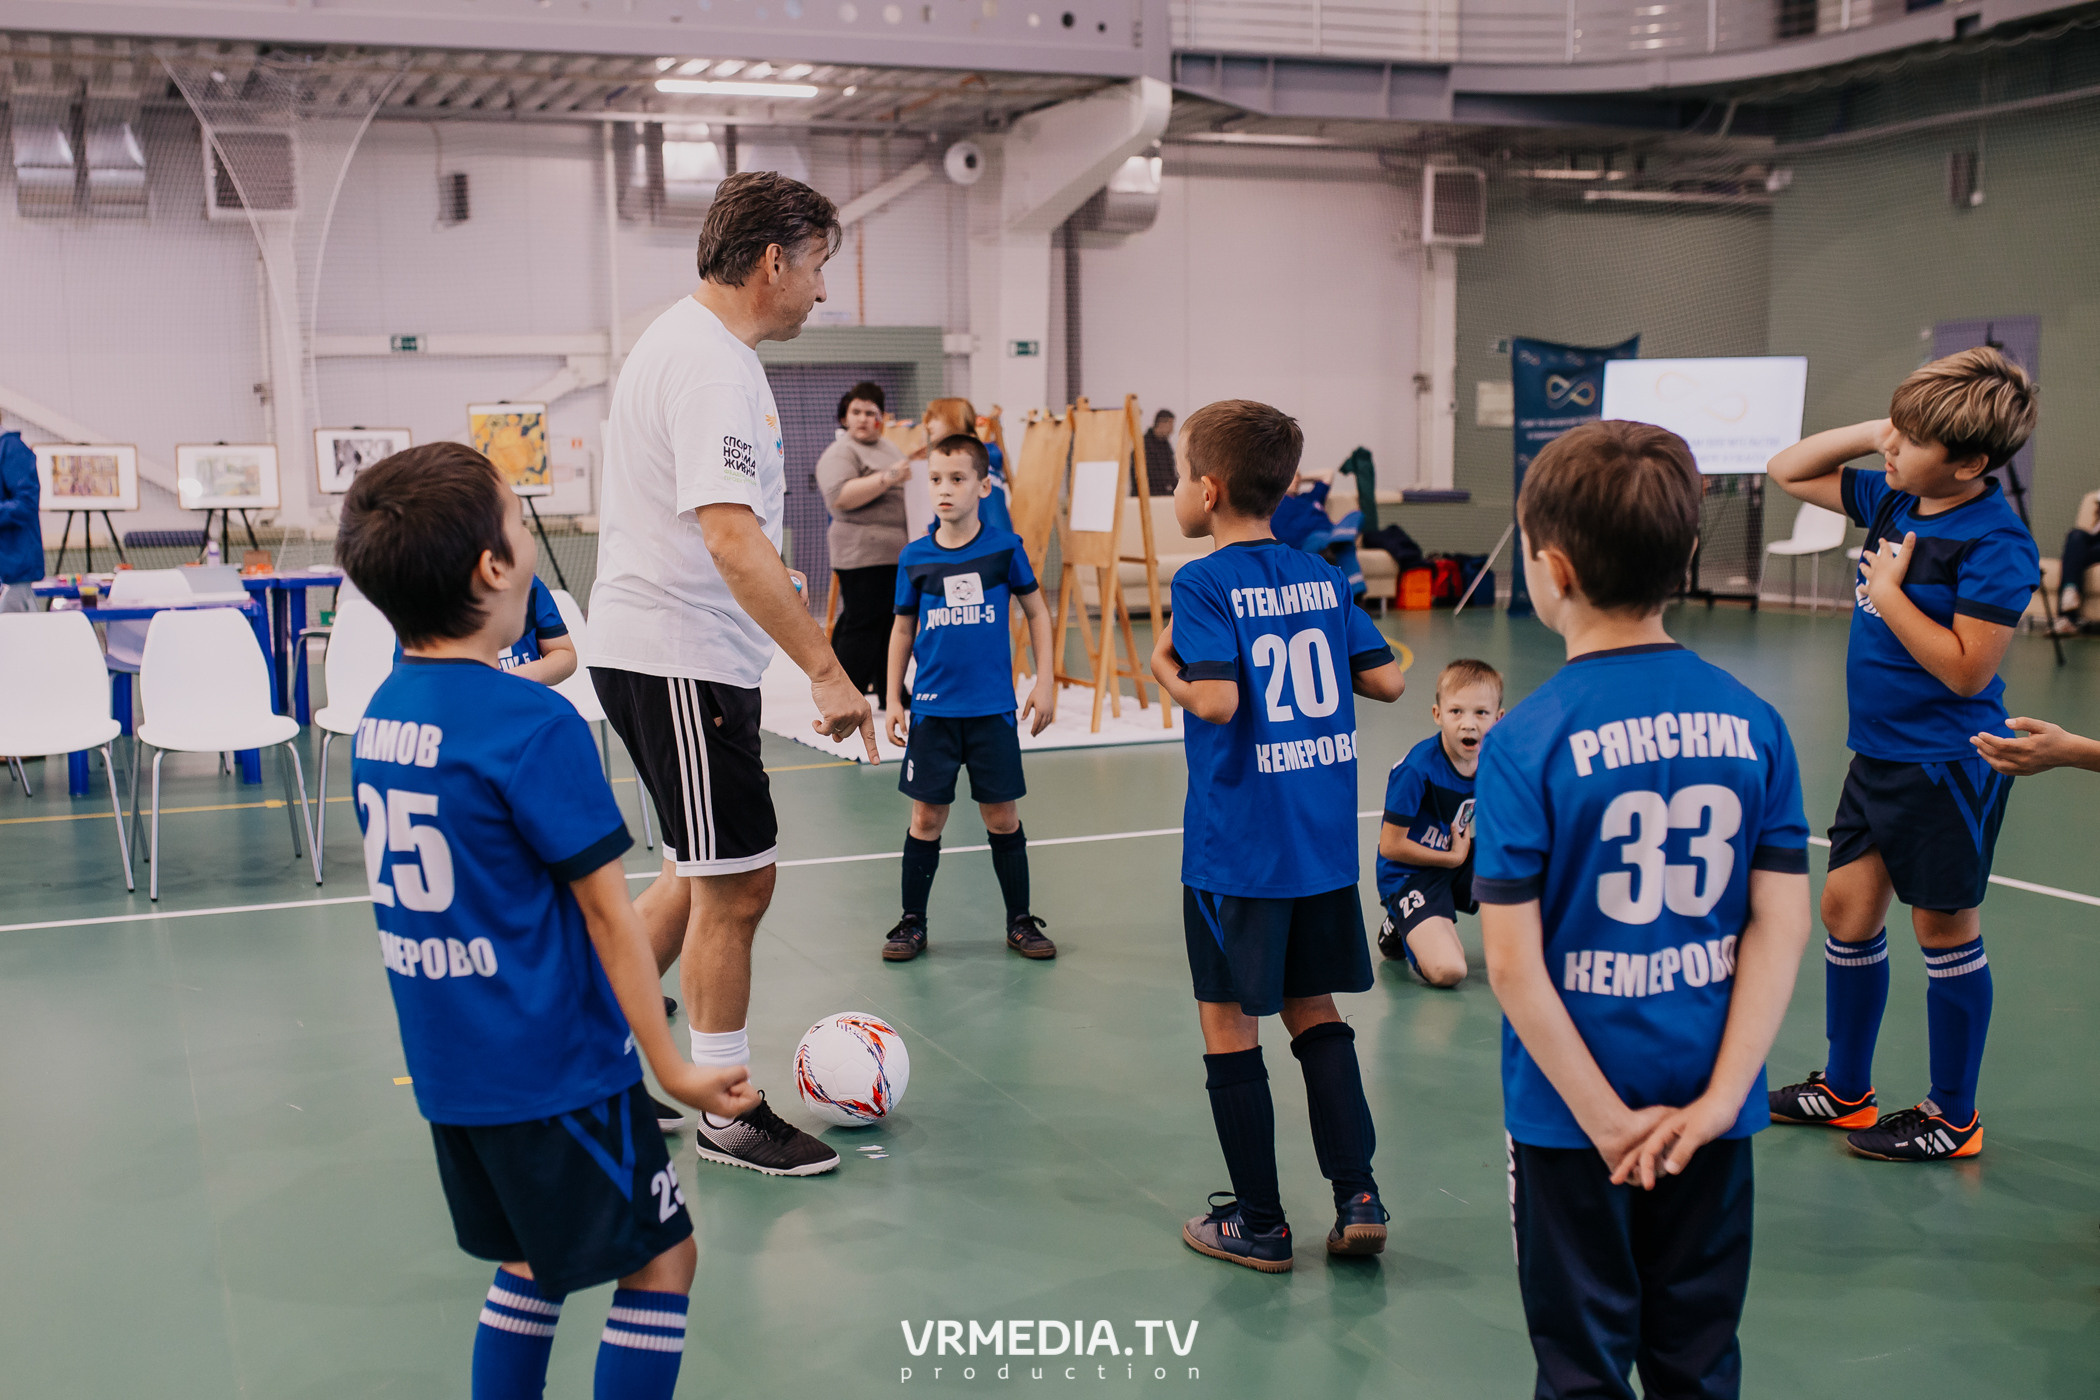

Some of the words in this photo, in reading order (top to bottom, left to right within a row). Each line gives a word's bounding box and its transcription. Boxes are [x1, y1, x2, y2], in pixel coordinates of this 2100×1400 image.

[723, 435, 752, 455] СПОРТ
[723, 446, 756, 470] НОМА
[925, 604, 996, 631] ДЮСШ-5
[1251, 627, 1340, 722] 20
[1568, 711, 1758, 778] РЯКСКИХ
[906, 759, 915, 783] 6
[357, 781, 455, 913] 25
[1596, 783, 1743, 925] 33
[1399, 889, 1426, 919] 23
[1563, 934, 1738, 998] КЕМЕРОВО
